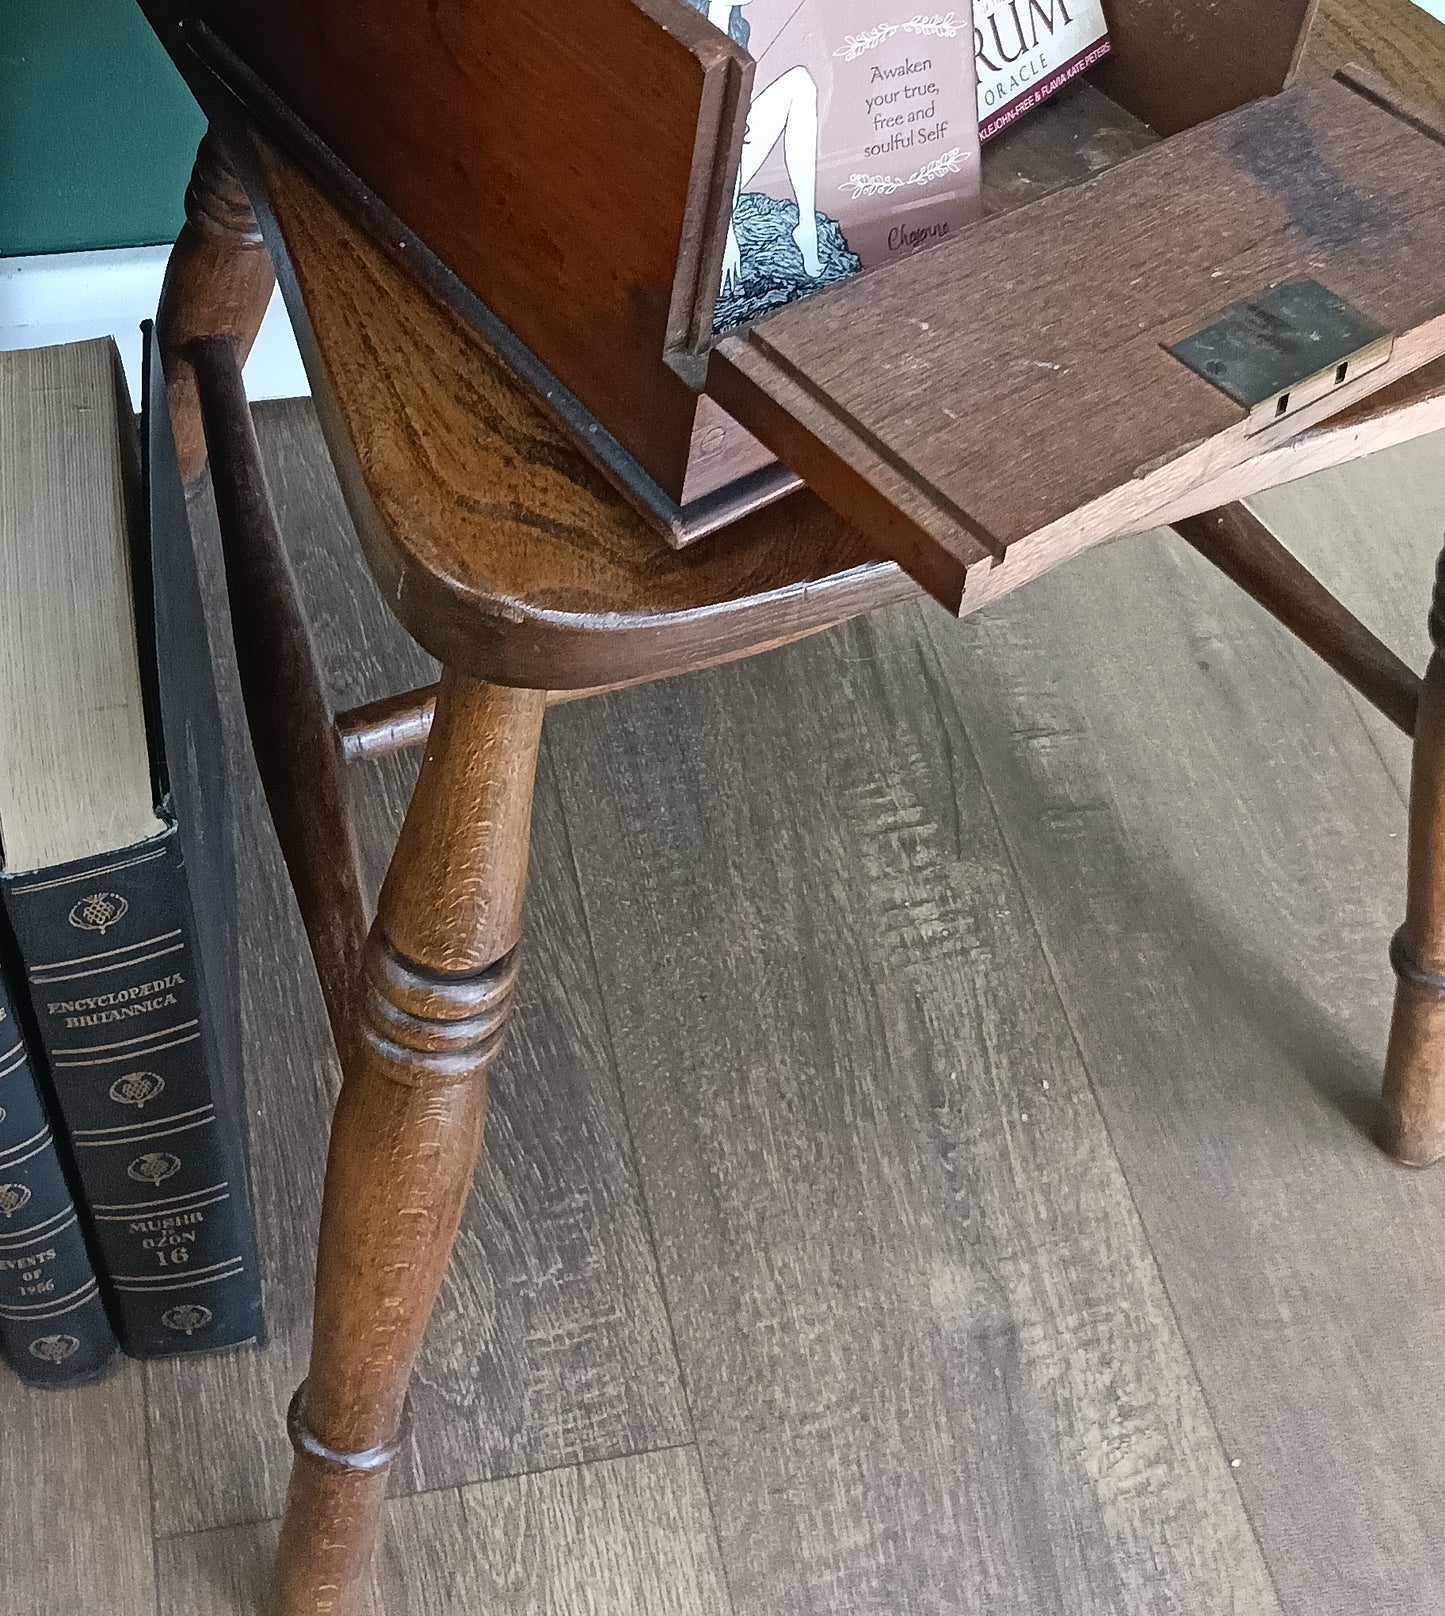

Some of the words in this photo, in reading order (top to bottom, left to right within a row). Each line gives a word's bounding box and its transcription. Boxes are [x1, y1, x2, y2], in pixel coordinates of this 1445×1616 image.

[870, 58, 932, 83] Awaken
[984, 53, 1048, 106] ORACLE
[1034, 91, 1041, 102] &
[1041, 73, 1067, 97] FLAVIA
[1066, 59, 1086, 79] KATE
[1085, 41, 1111, 66] PETERS
[865, 90, 899, 114] your
[904, 82, 939, 99] true,
[873, 113, 904, 131] free
[908, 100, 935, 122] and
[864, 130, 914, 158] soulful
[918, 121, 949, 145] Self
[65, 993, 177, 1028] BRITANNICA
[156, 1247, 189, 1266] 16
[23, 1268, 42, 1281] OF
